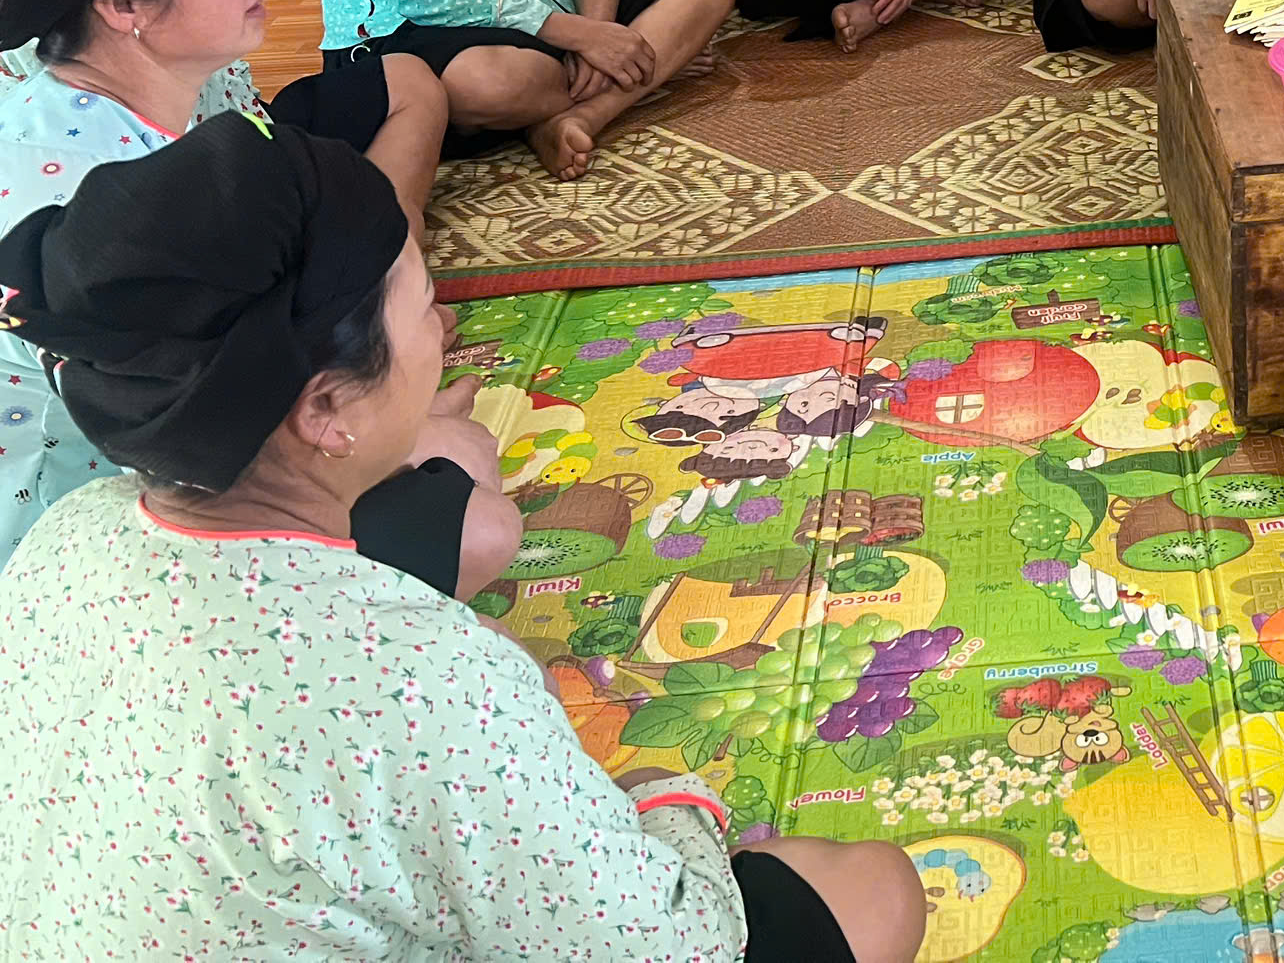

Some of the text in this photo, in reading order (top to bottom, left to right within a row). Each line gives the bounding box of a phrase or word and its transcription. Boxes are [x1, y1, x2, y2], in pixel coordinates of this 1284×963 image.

[1028, 303, 1087, 316] Garden
[1041, 312, 1080, 324] Fruit
[922, 451, 975, 464] Apple
[526, 576, 581, 599] Kiwi
[985, 661, 1098, 680] Strawberry
[1131, 721, 1169, 768] Ladder
